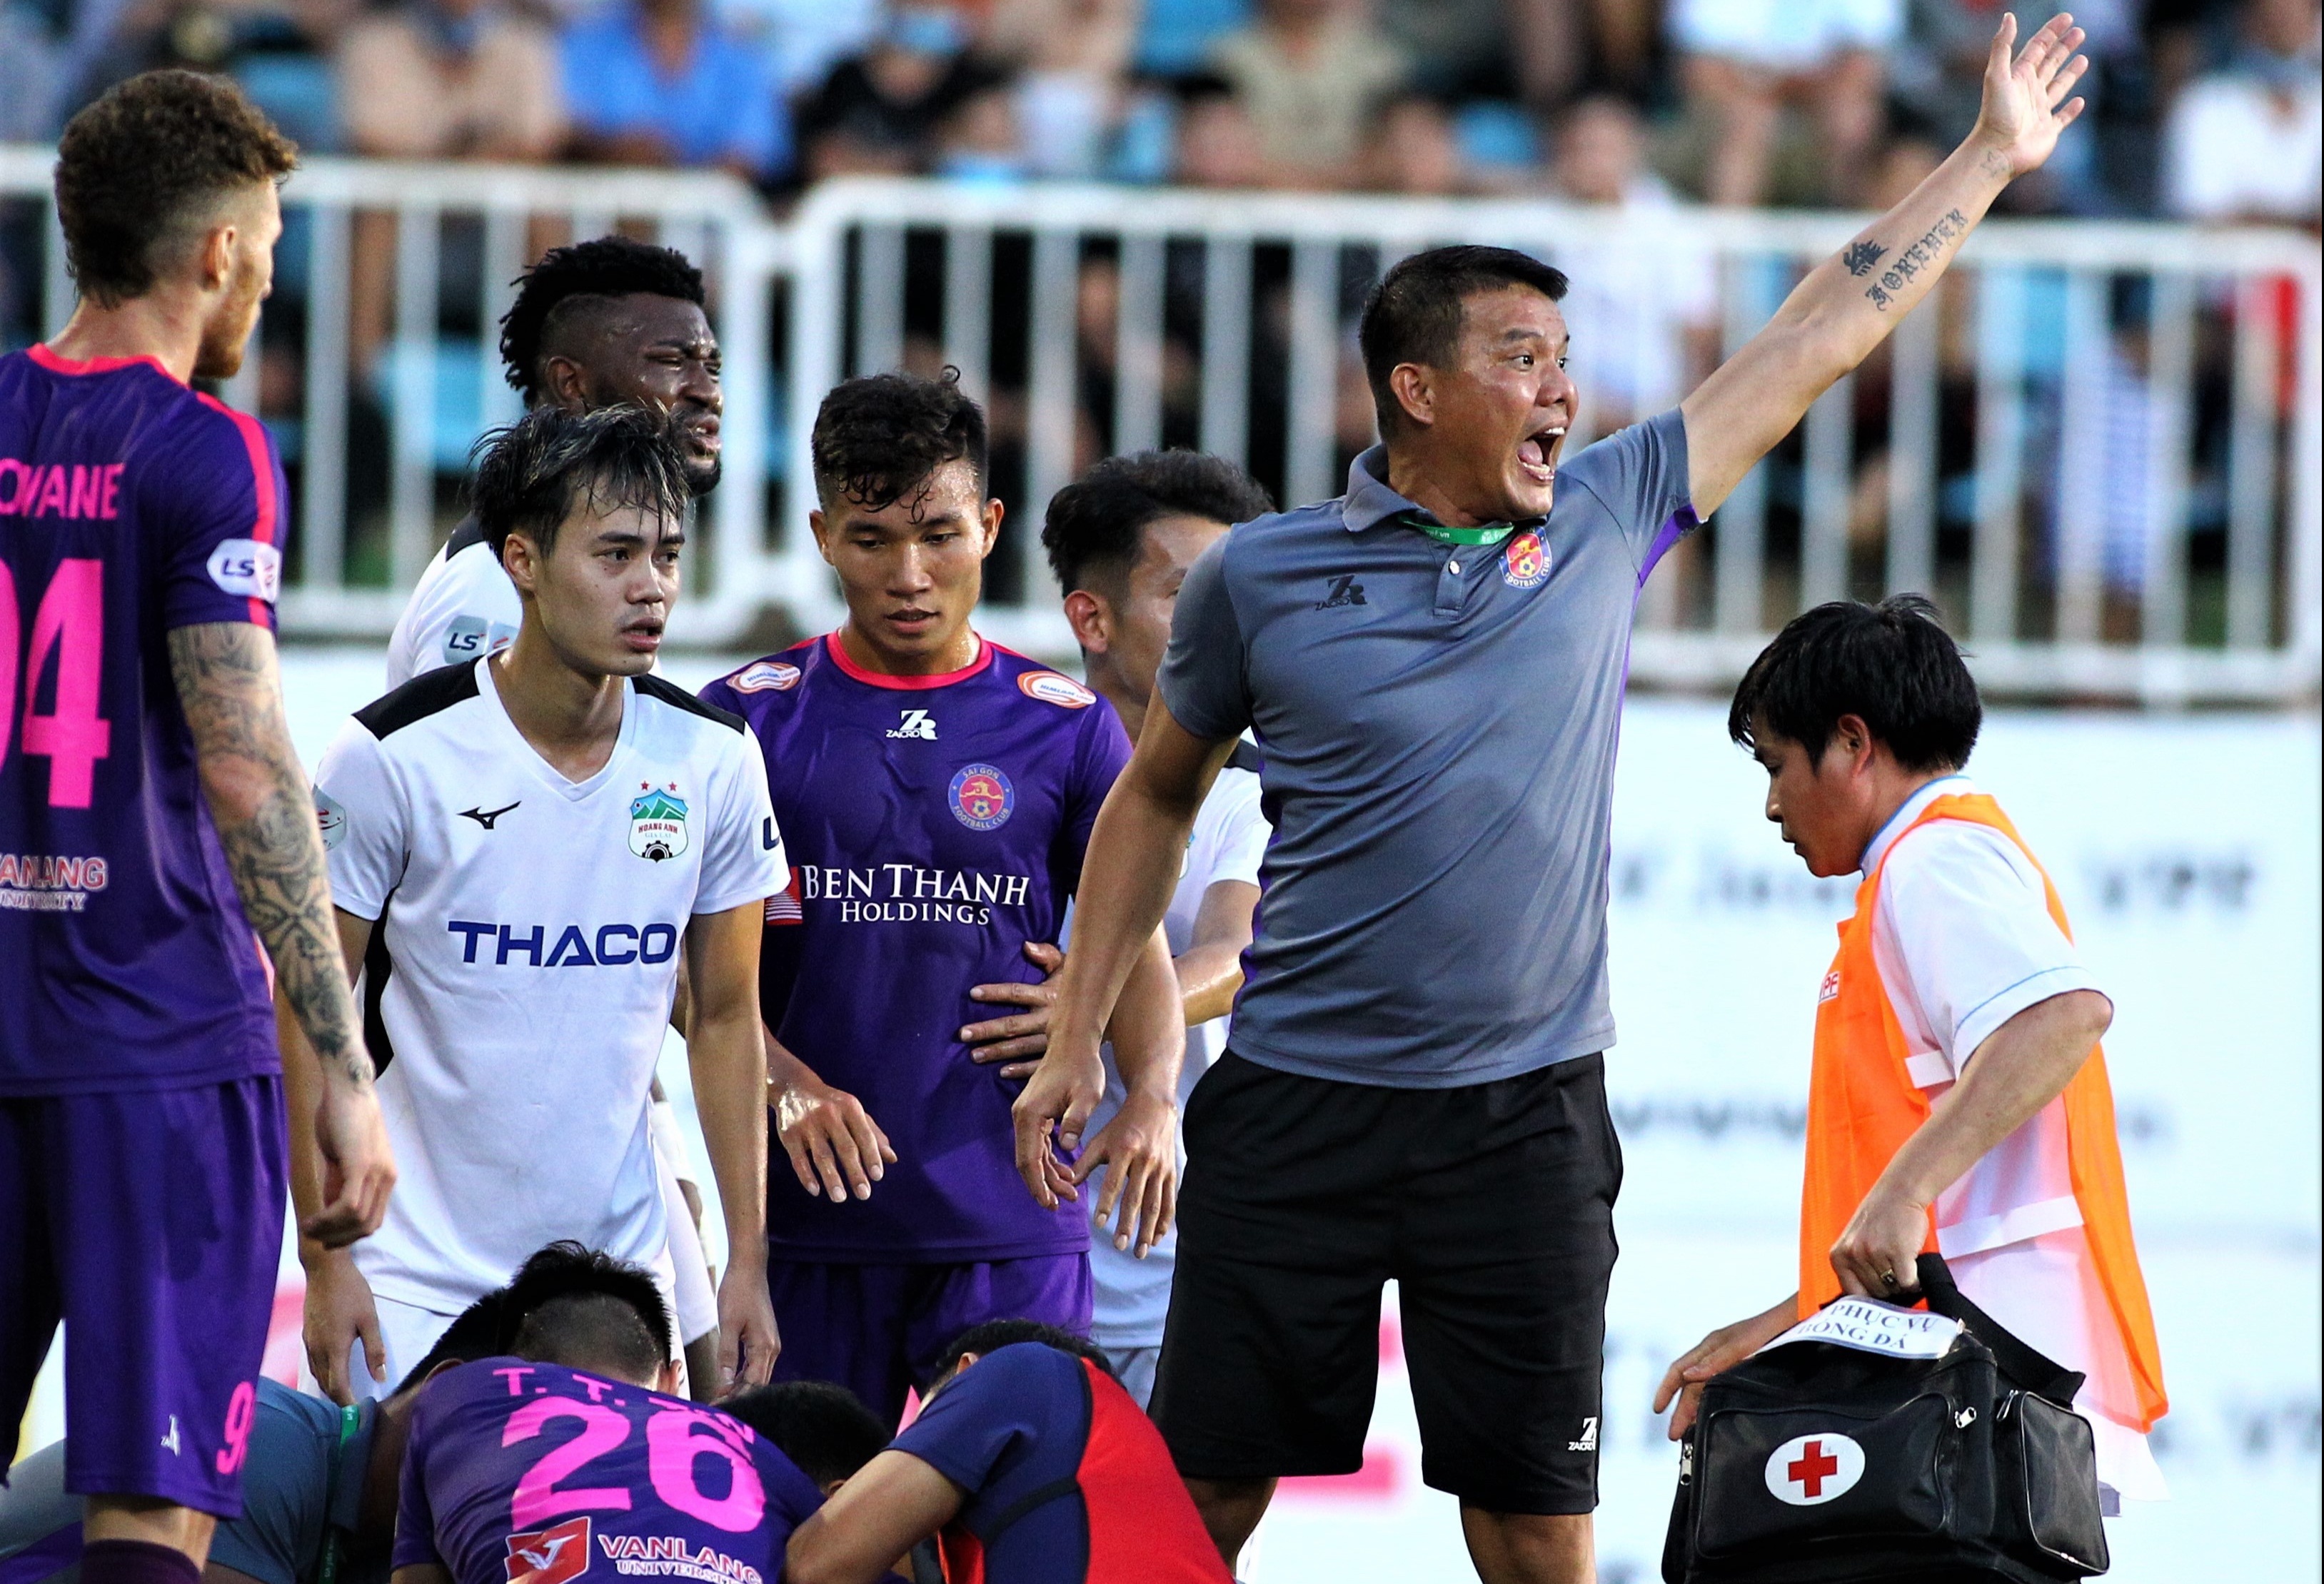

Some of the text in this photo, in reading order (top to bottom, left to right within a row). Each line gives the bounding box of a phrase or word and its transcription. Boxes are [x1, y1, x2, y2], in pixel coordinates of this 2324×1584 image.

[1505, 572, 1542, 587] FOOTBALL
[448, 632, 481, 651] LS
[0, 558, 111, 809] 4
[962, 767, 999, 779] SAI GON
[638, 822, 678, 834] HOANG ANH
[954, 805, 1009, 828] FOOTBALL CLUB
[801, 863, 1030, 907] BEN THANH
[840, 901, 991, 926] HOLDINGS
[448, 920, 677, 967] THACO
[1830, 1305, 1900, 1328] PHỤC
[501, 1396, 767, 1533] 26
